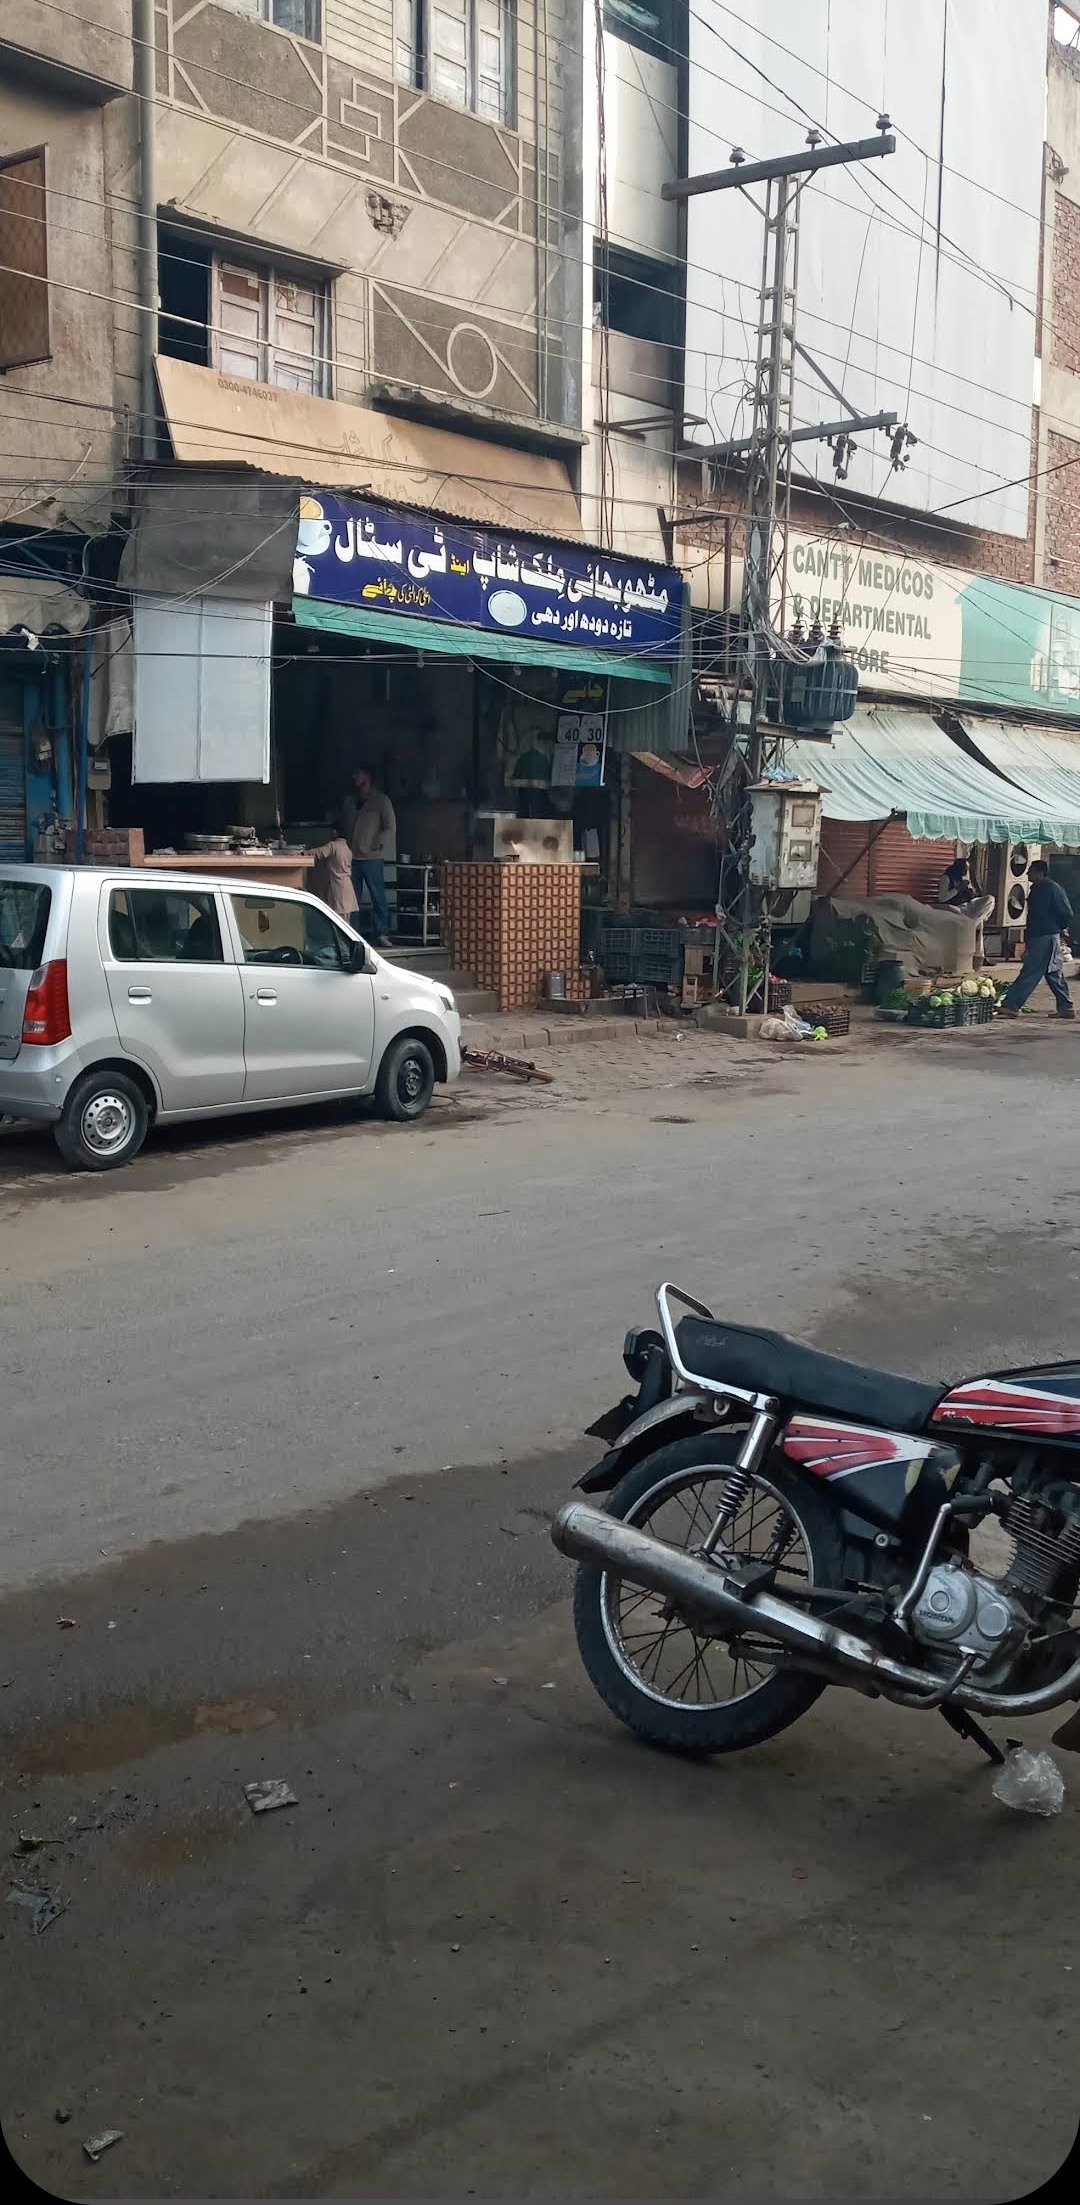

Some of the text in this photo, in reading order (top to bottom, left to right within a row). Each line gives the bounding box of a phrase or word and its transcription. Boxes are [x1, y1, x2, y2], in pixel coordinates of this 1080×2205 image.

[334, 516, 403, 564] سٹال
[407, 526, 447, 579] ٹی
[792, 544, 934, 600] CANTT MEDICOS
[560, 609, 579, 632] اور
[580, 612, 609, 637] دودھ
[809, 596, 932, 640] DEPARTMENTAL
[564, 728, 580, 742] 40
[587, 728, 603, 742] 30
